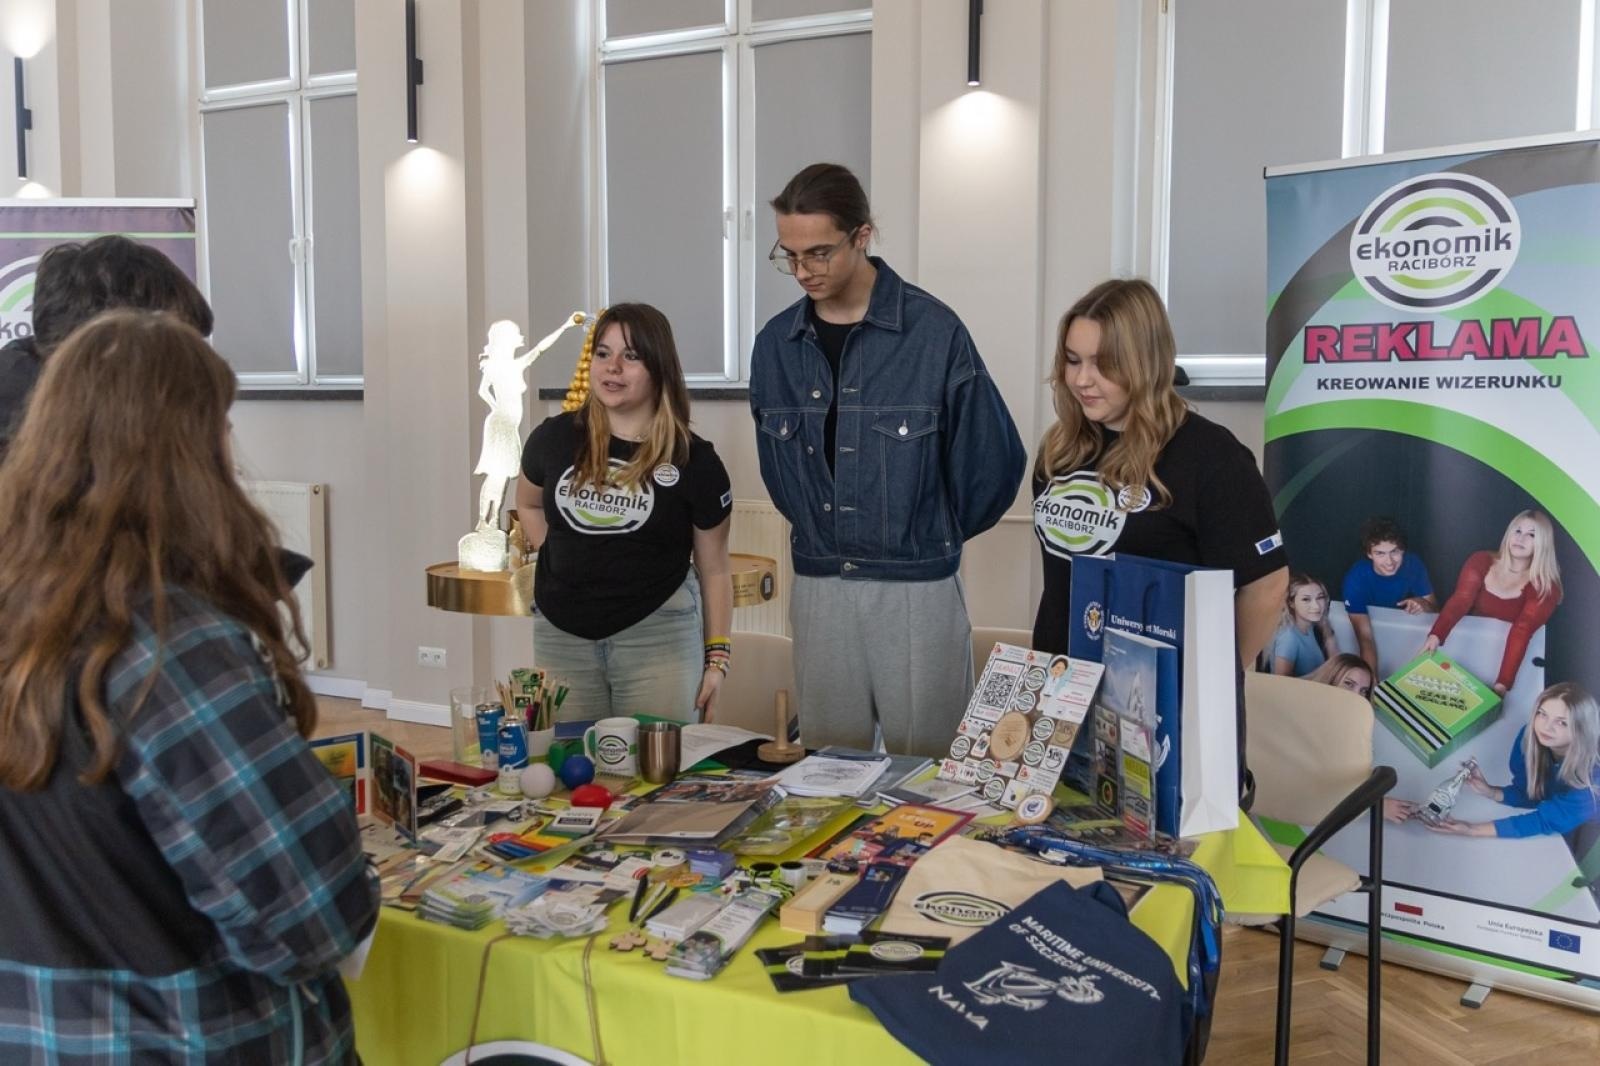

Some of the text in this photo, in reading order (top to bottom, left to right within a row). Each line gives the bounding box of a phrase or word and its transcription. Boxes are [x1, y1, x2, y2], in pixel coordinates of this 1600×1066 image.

[1356, 227, 1512, 261] ekonomik
[1388, 255, 1477, 272] RACIBÓRZ
[1303, 316, 1590, 364] REKLAMA
[1317, 375, 1562, 390] KREOWANIE WIZERUNKU
[574, 499, 627, 516] RACIBÓRZ
[1045, 516, 1096, 535] RACIBÓRZ
[1152, 624, 1176, 640] Morski
[914, 901, 1010, 918] ekonomi
[1008, 922, 1088, 973] OF SZCZECIN
[1020, 915, 1162, 1001] MARITIME UNIVERSITY
